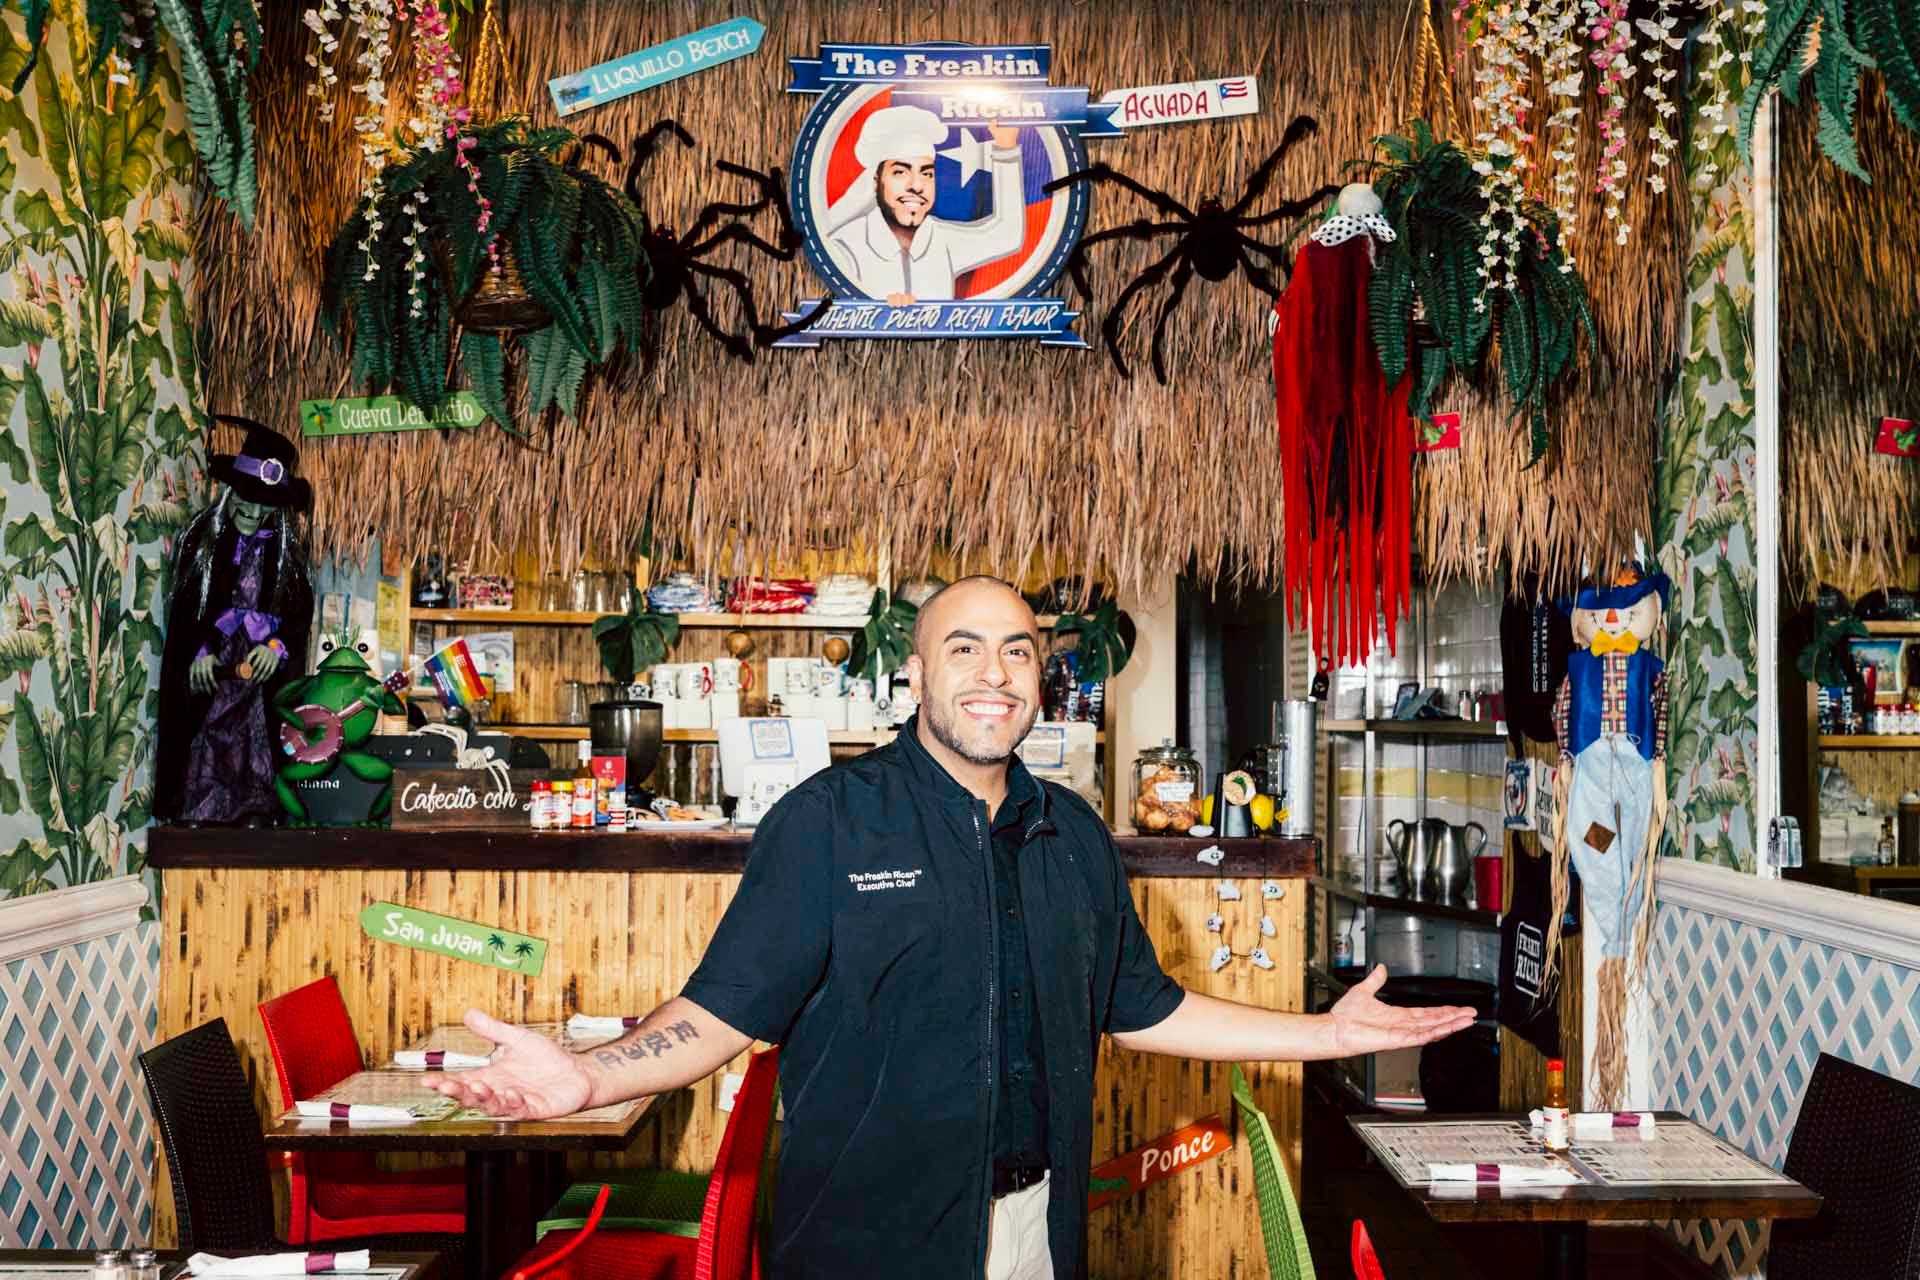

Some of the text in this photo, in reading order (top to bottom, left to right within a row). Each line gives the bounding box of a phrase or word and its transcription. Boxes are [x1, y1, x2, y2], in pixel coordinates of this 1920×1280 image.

[591, 28, 750, 94] LUQUILLO BEACH
[831, 52, 1041, 77] The Freakin
[941, 97, 1046, 119] Rican
[1124, 90, 1209, 122] AGUADA
[806, 305, 882, 332] UTHENTIC
[948, 306, 990, 331] RICAN
[998, 305, 1060, 332] FLAVOR
[339, 403, 393, 430] Cueva
[401, 782, 478, 812] Cafecito
[483, 791, 518, 809] con
[848, 873, 864, 883] The
[865, 870, 892, 881] Freakin
[857, 878, 915, 891] Executive Chef
[383, 911, 484, 955] San Juan
[1141, 1130, 1216, 1183] Ponce
